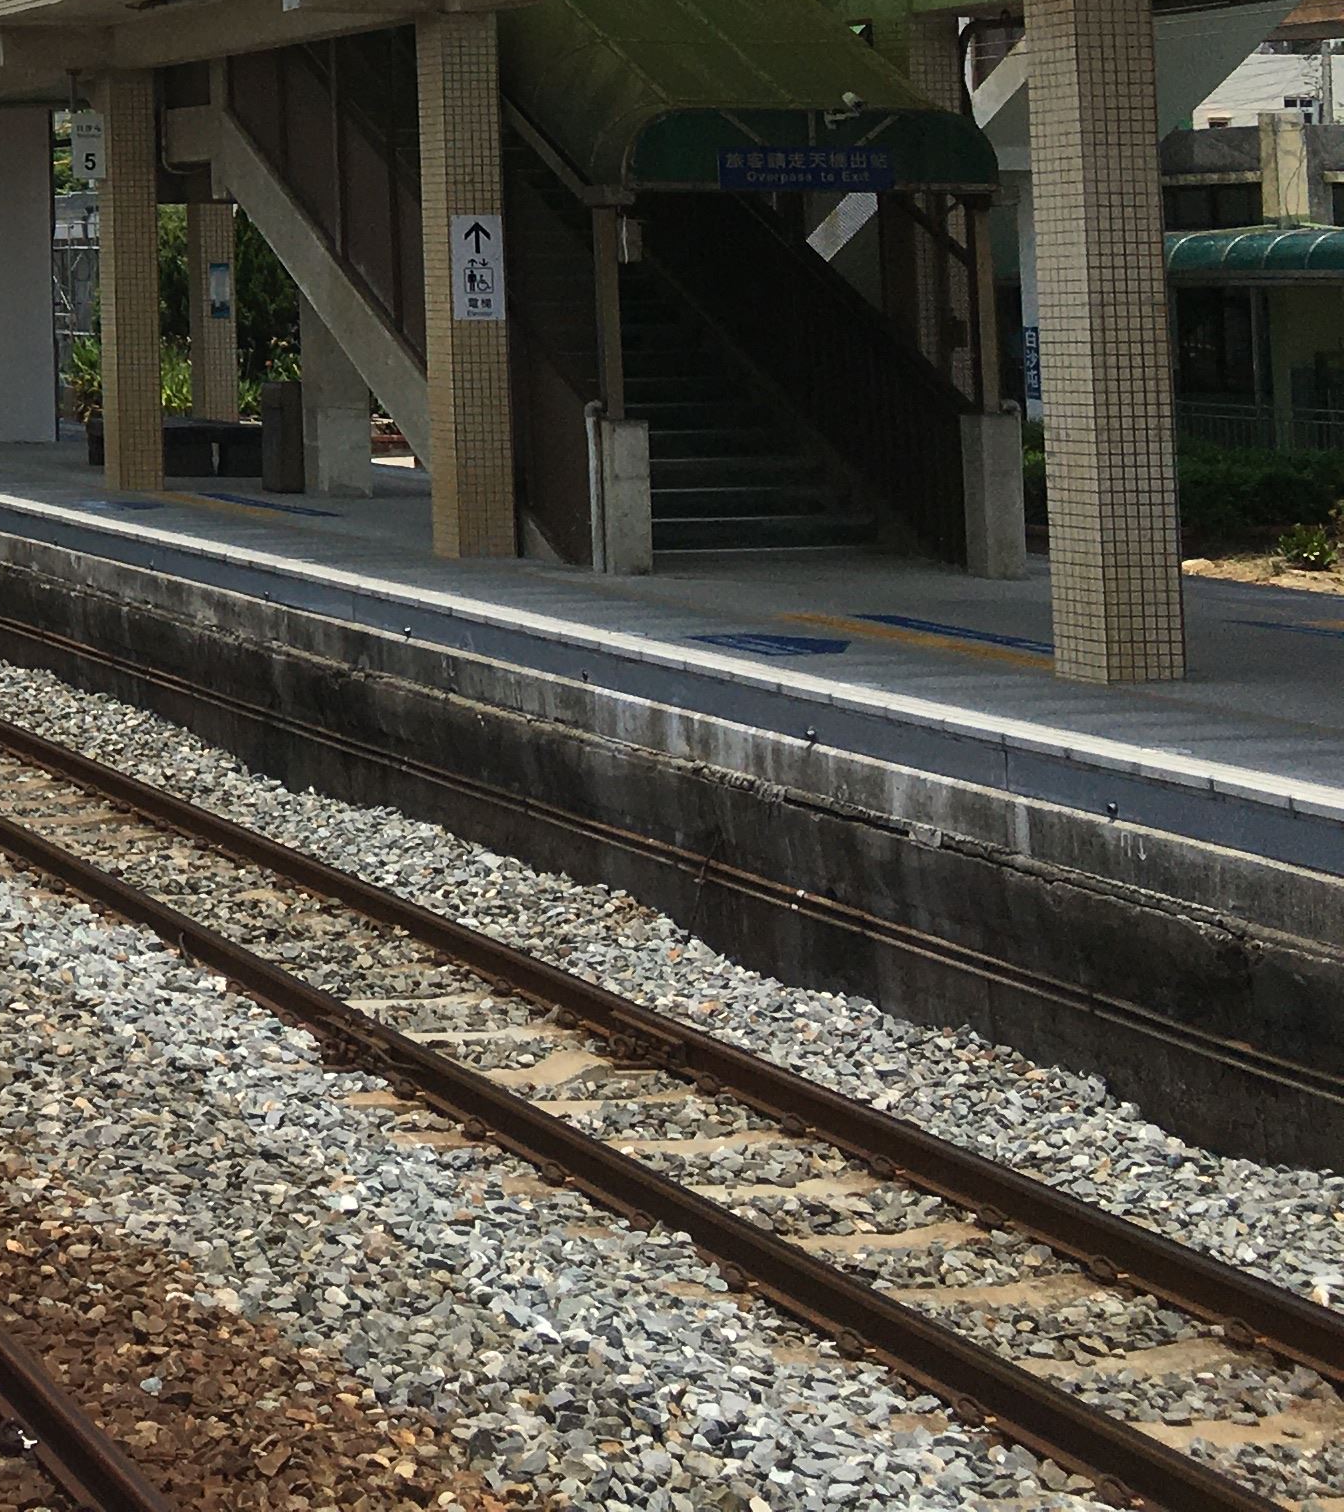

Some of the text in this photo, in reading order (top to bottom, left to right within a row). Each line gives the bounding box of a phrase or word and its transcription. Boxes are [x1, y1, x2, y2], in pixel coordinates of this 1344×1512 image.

[84, 153, 96, 170] 5
[820, 172, 836, 182] to
[841, 171, 871, 182] Exit
